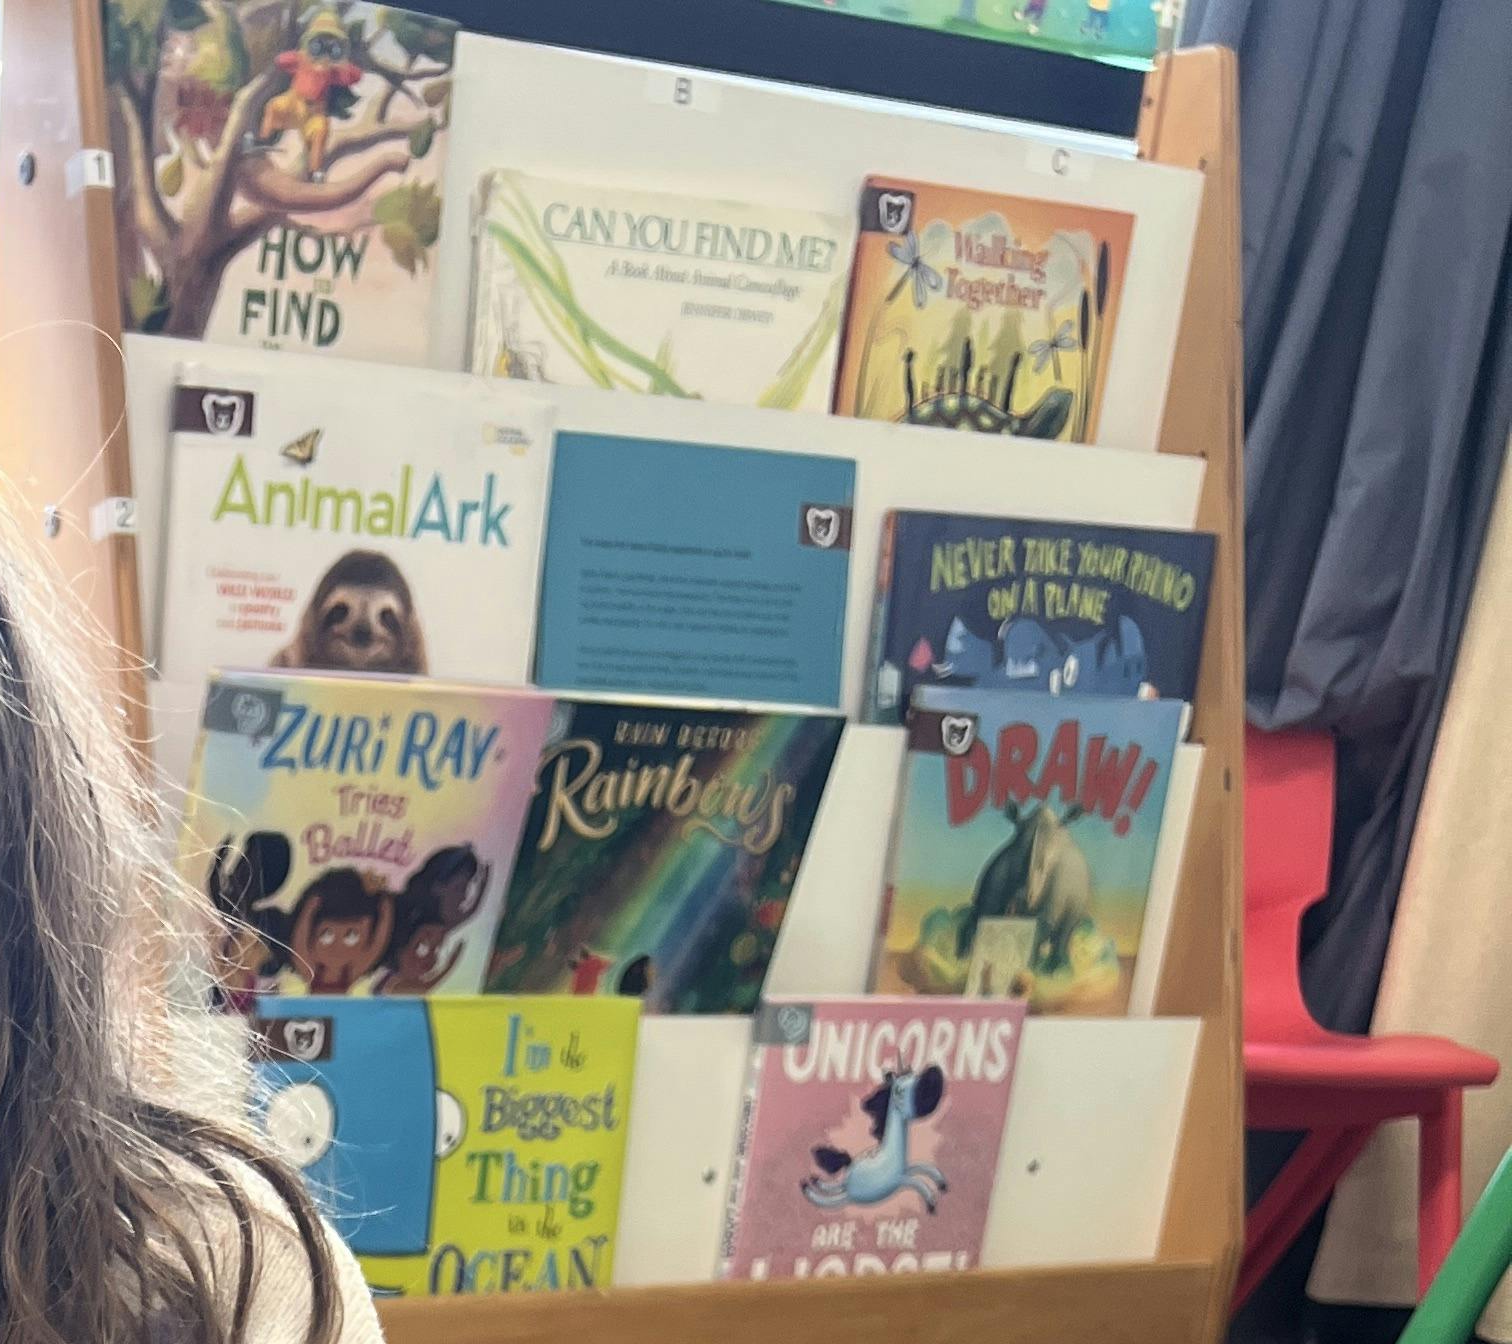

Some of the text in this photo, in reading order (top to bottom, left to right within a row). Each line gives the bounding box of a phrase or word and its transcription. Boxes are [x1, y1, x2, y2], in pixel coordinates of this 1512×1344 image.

[257, 226, 370, 284] HOW
[543, 202, 838, 273] CAN YOU FIND ME?
[240, 288, 340, 347] FIND
[930, 535, 1017, 592] NEVER
[1022, 537, 1074, 577] TAKE
[1125, 551, 1196, 613] RHINO
[987, 577, 1111, 626] ON A PLANE
[398, 711, 502, 791] RAY
[946, 718, 1159, 839] DRAW!
[337, 783, 410, 819] Tries
[536, 738, 798, 854] Rainbows
[303, 822, 417, 867] Ballet
[502, 1014, 587, 1076] I'm the
[782, 1016, 1014, 1083] UNICORNS
[481, 1083, 620, 1141] Biggest
[465, 1149, 601, 1219] Thing
[810, 1217, 920, 1251] ARE THE
